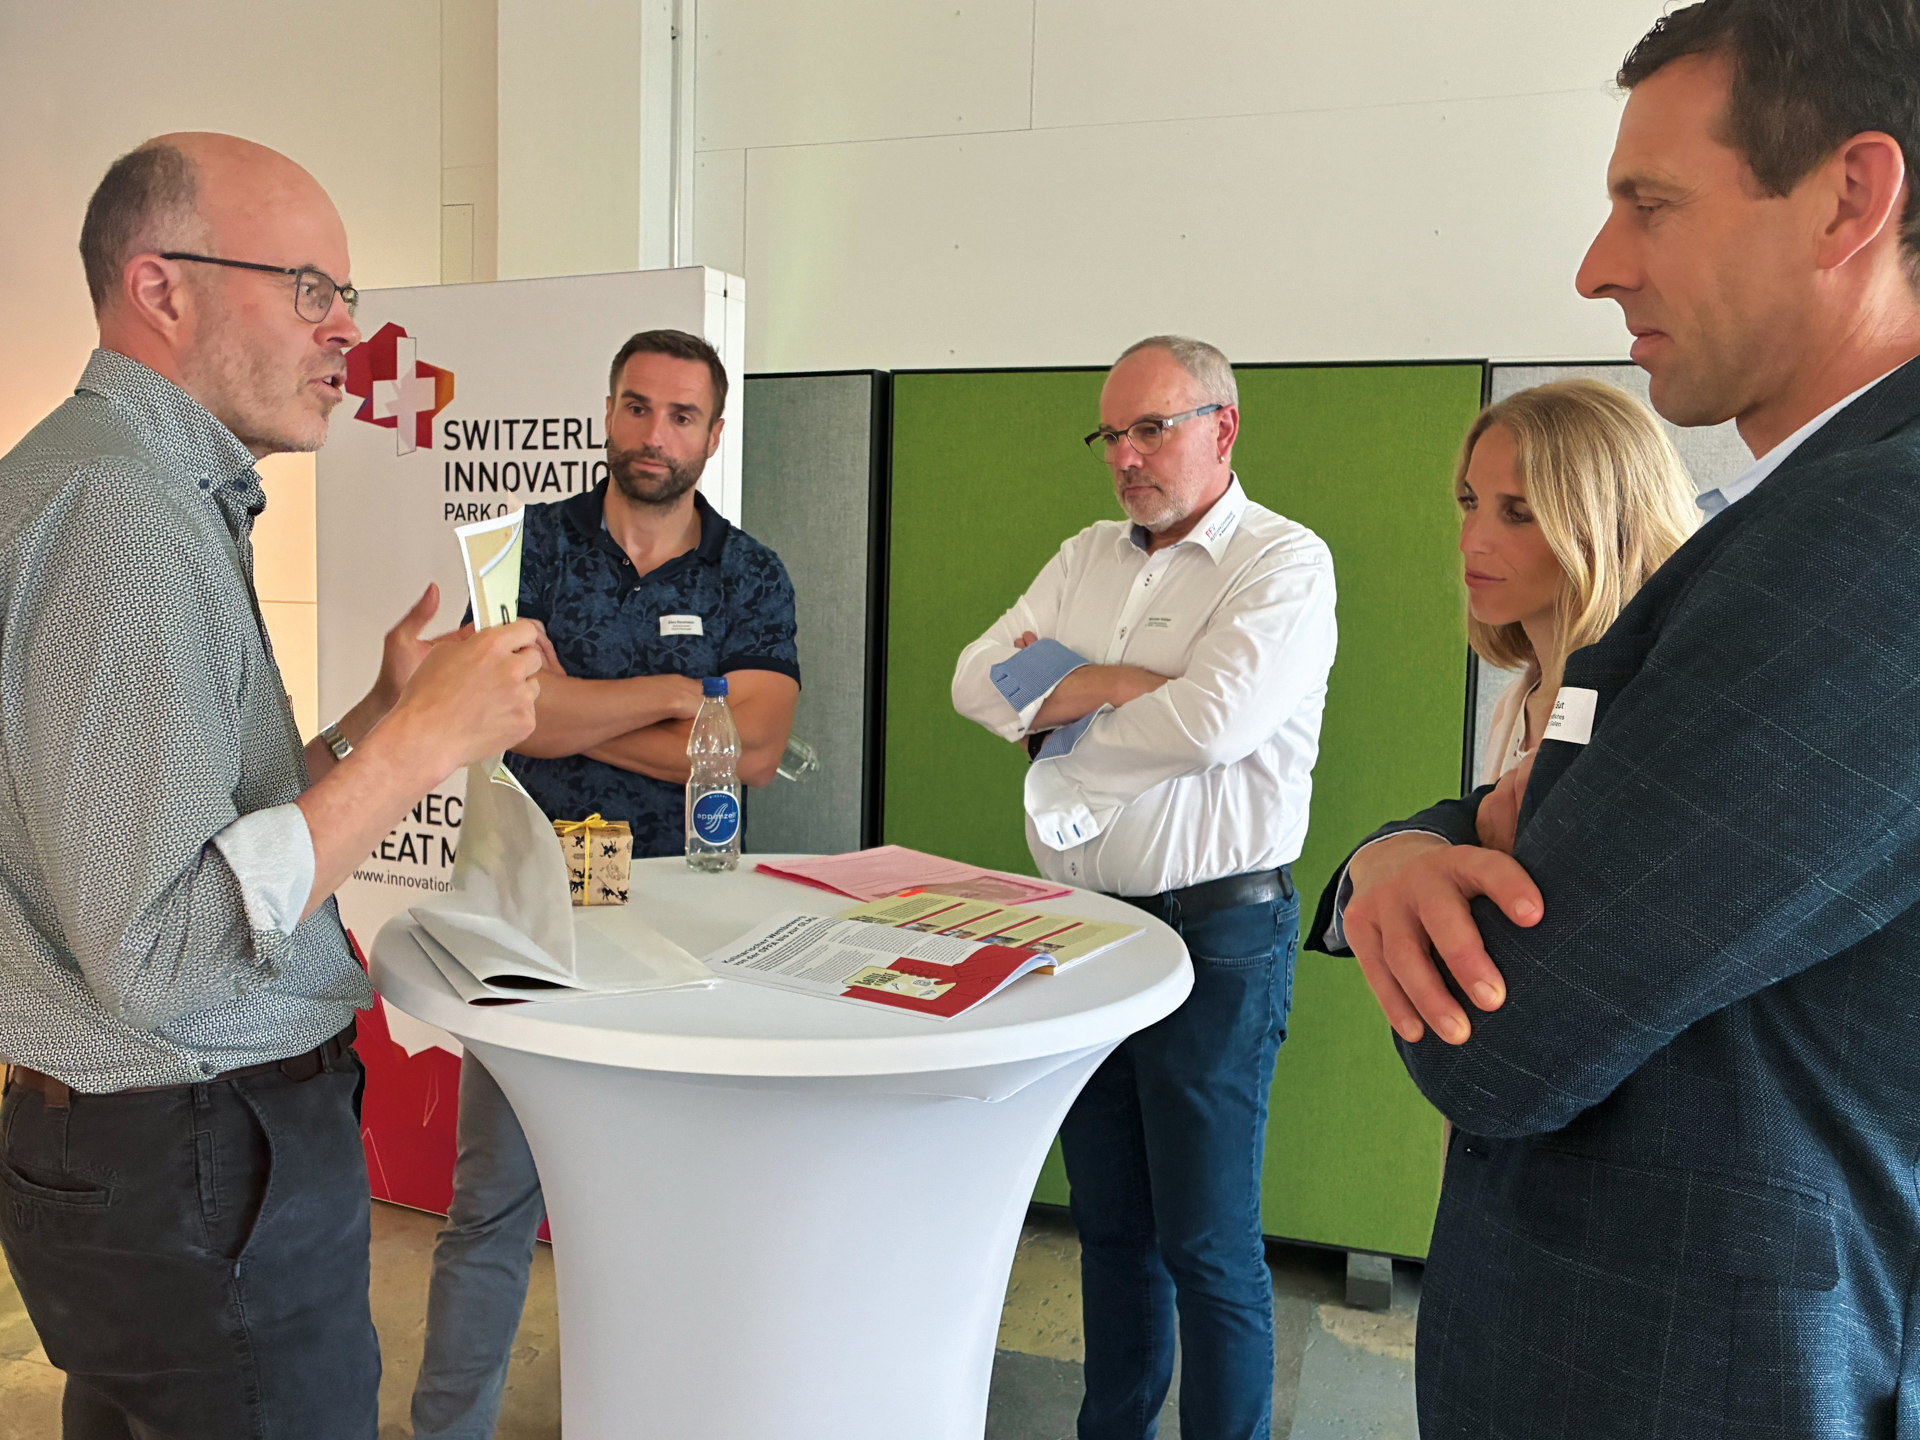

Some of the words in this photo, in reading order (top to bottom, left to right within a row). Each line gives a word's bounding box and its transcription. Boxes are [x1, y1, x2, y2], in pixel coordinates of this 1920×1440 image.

[444, 418, 608, 450] SWITZERL
[445, 502, 491, 521] PARK
[402, 794, 463, 828] NEC
[371, 830, 434, 865] EAT
